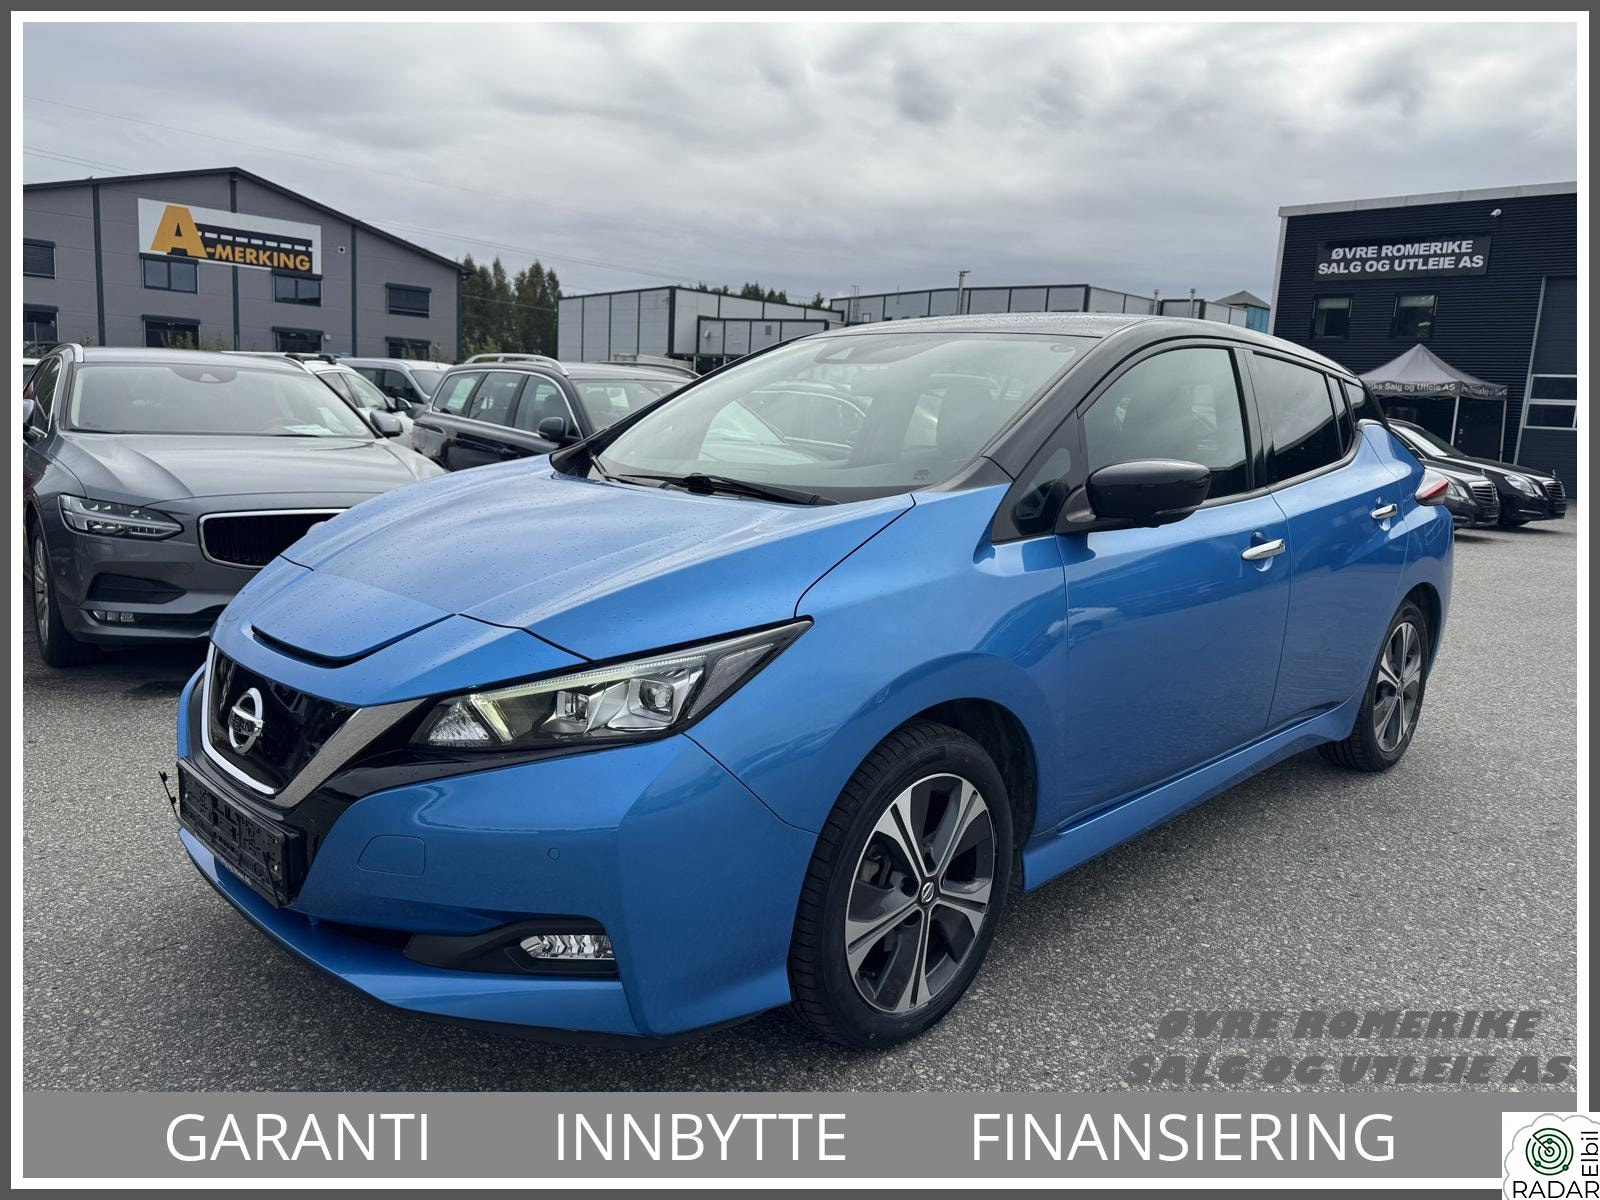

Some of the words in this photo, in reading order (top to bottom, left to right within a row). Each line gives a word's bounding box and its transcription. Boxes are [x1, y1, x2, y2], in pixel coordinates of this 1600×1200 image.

[151, 204, 311, 271] A-MERKING
[1331, 245, 1379, 260] ØVRE
[1381, 240, 1474, 257] ROMERIKE
[1317, 261, 1361, 275] SALG
[1365, 260, 1390, 272] OG
[1393, 256, 1456, 271] UTLEIE
[1458, 255, 1484, 268] AS
[1442, 383, 1456, 391] AS
